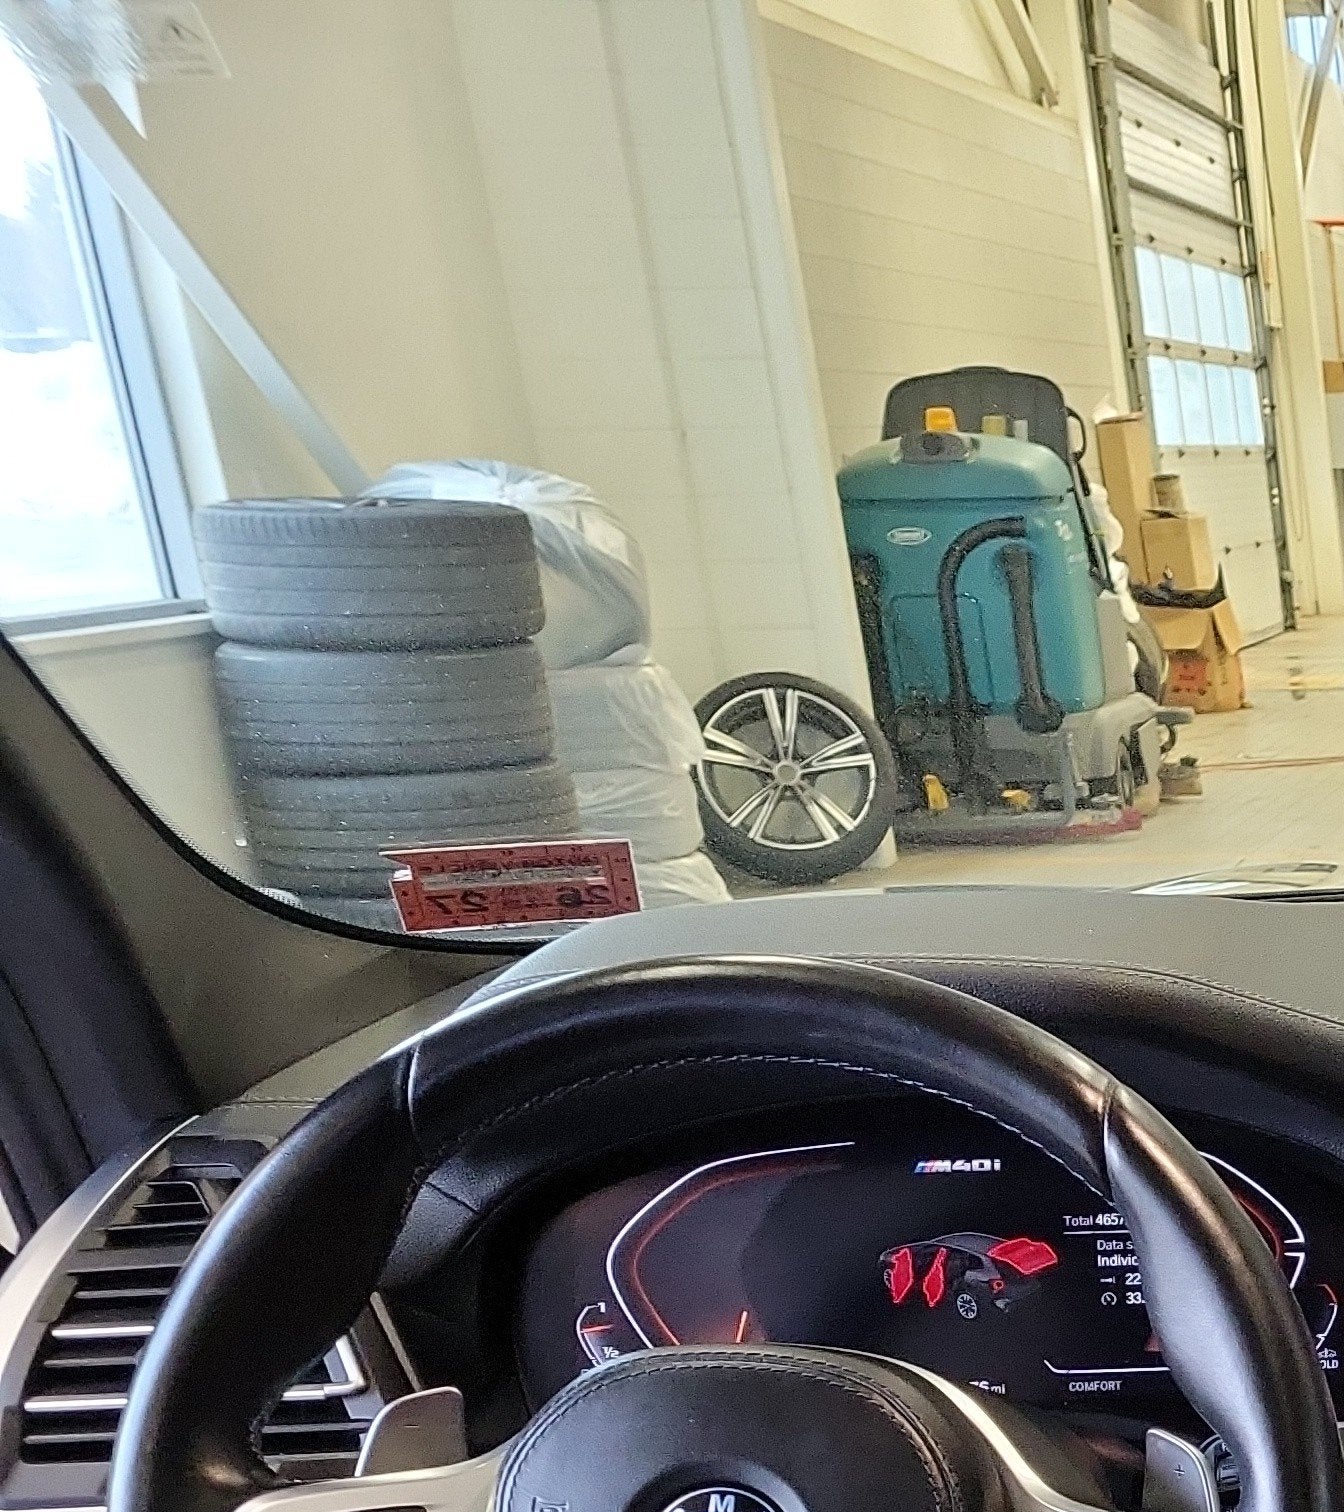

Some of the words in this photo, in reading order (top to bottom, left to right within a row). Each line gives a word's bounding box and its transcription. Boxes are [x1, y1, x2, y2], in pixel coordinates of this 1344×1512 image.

[1062, 1215, 1093, 1227] Total
[1096, 1239, 1124, 1251] Data
[1068, 1380, 1123, 1392] COMFORT
